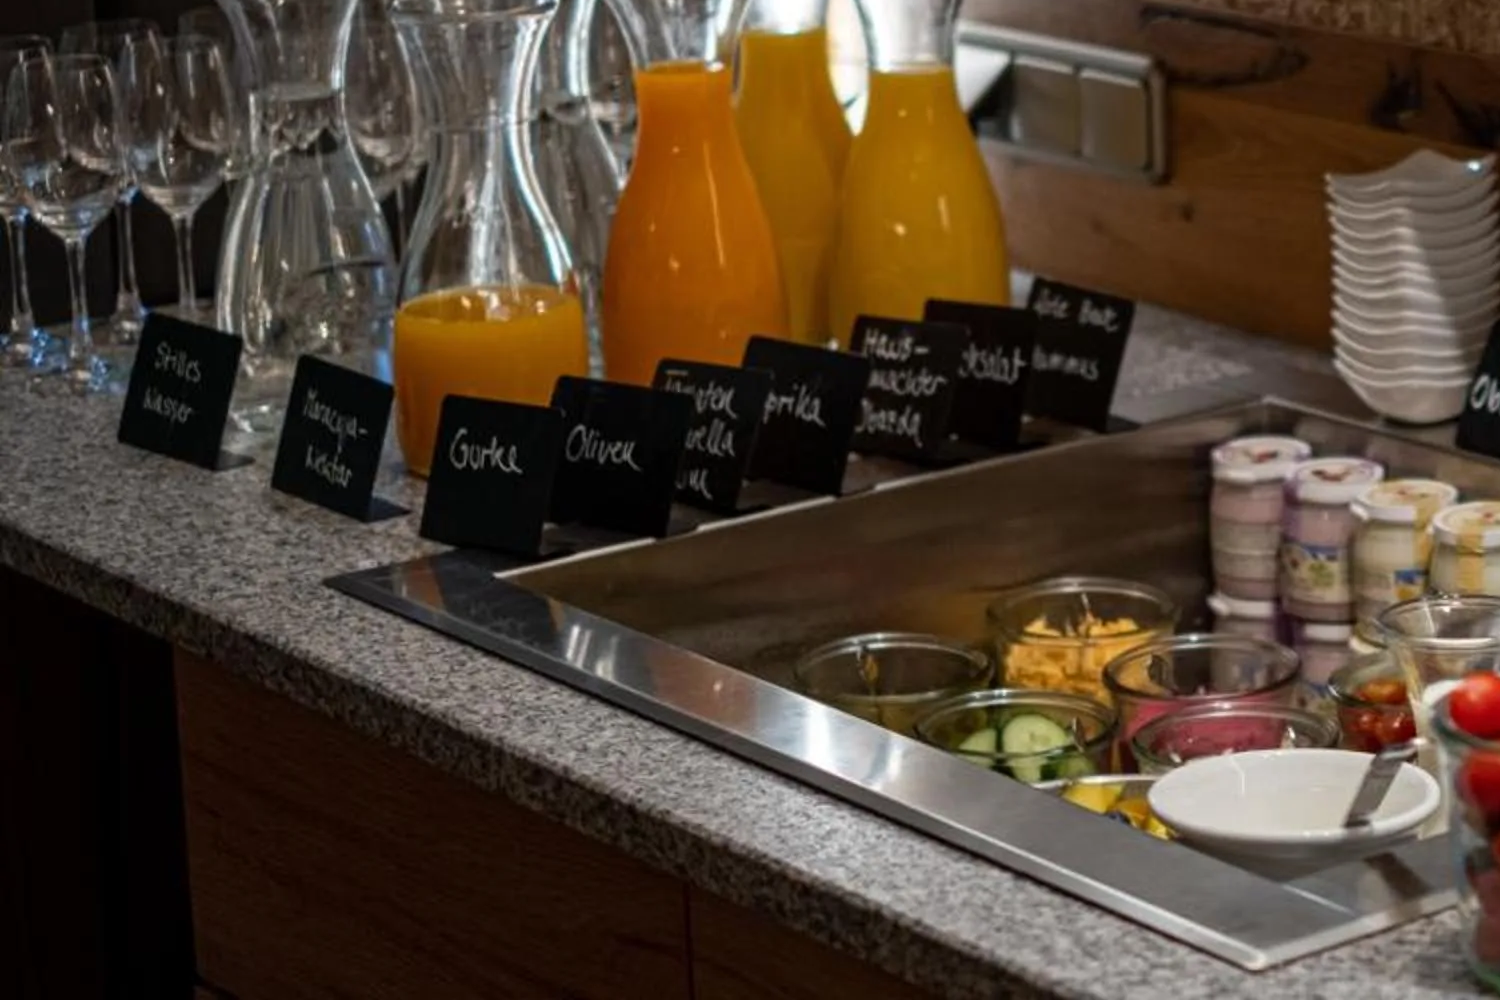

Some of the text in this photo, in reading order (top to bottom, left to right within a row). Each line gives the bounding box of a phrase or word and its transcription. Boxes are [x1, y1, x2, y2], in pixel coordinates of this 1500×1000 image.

[762, 374, 828, 429] prika
[450, 428, 523, 475] Gurke
[565, 423, 642, 472] Oliven
